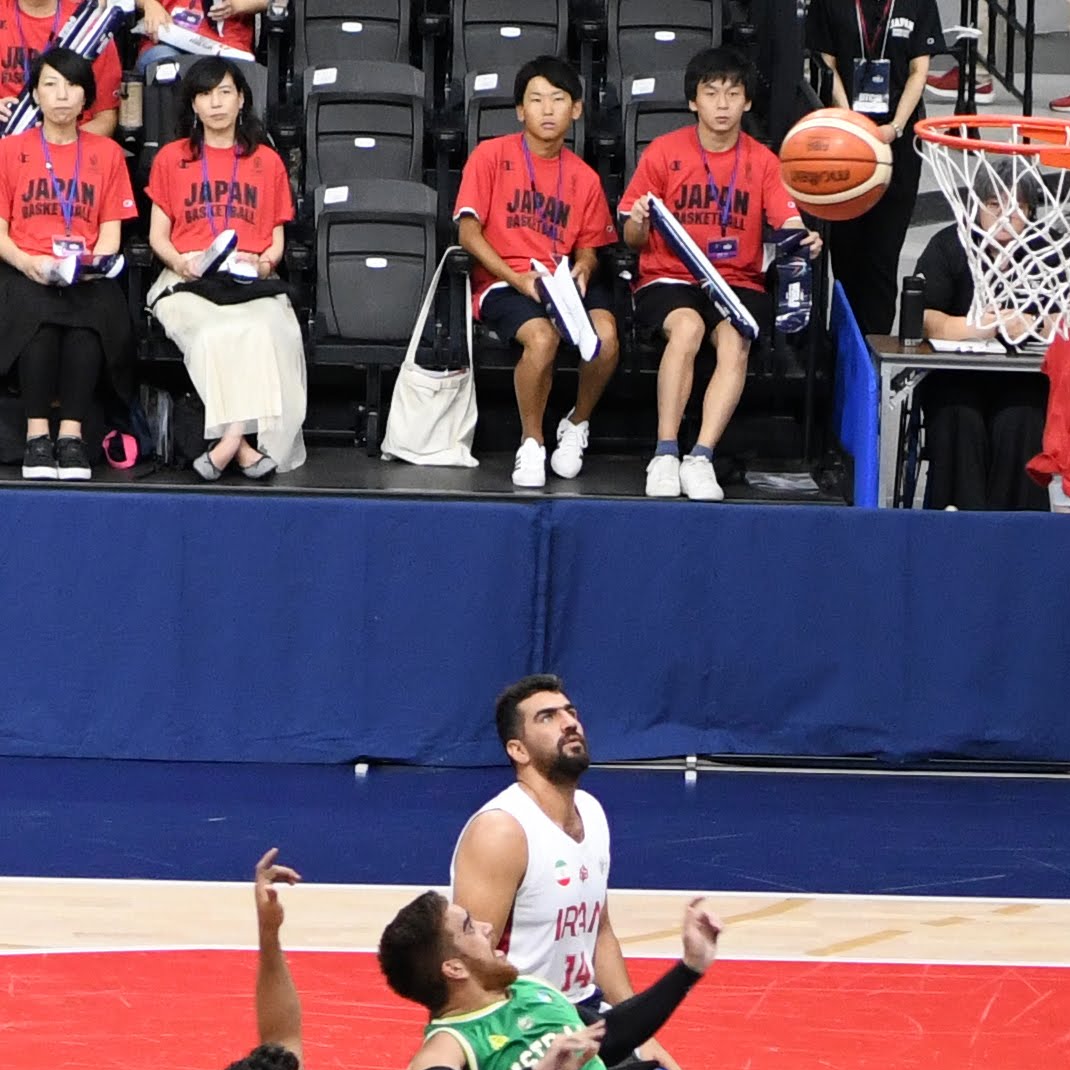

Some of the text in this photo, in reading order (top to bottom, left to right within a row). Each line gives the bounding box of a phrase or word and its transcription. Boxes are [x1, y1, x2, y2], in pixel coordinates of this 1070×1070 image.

[21, 178, 95, 208] JAPAN
[184, 180, 258, 209] JAPAN
[506, 188, 571, 228] JAPAN
[674, 183, 749, 216] JAPAN
[21, 202, 92, 223] BASKEALL
[673, 211, 746, 231] ASKETALL
[561, 951, 592, 992] 14
